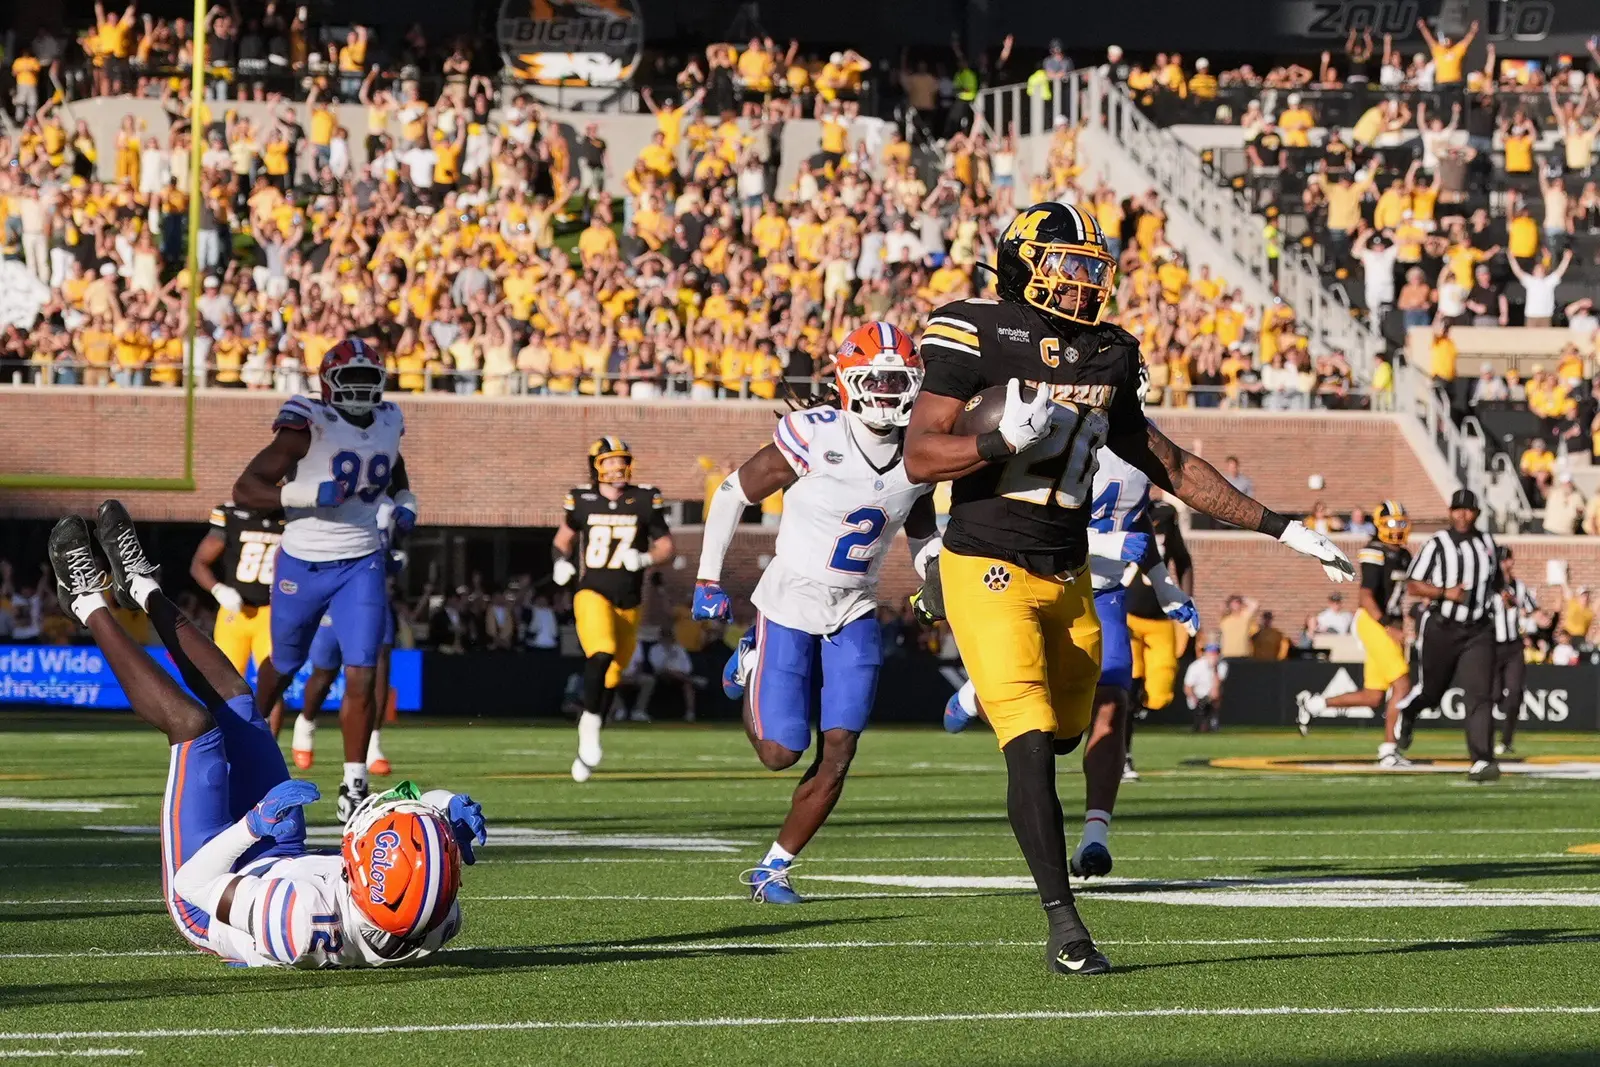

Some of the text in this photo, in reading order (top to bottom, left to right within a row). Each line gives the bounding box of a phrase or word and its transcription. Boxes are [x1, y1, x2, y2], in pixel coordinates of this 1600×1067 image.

[514, 20, 629, 42] BIG MO
[1005, 210, 1052, 242] M
[1039, 337, 1060, 368] C
[994, 397, 1110, 510] 20
[585, 524, 638, 569] 87
[826, 504, 890, 576] 2
[38, 648, 102, 674] Wide
[369, 829, 401, 906] Gators
[309, 912, 345, 955] 12
